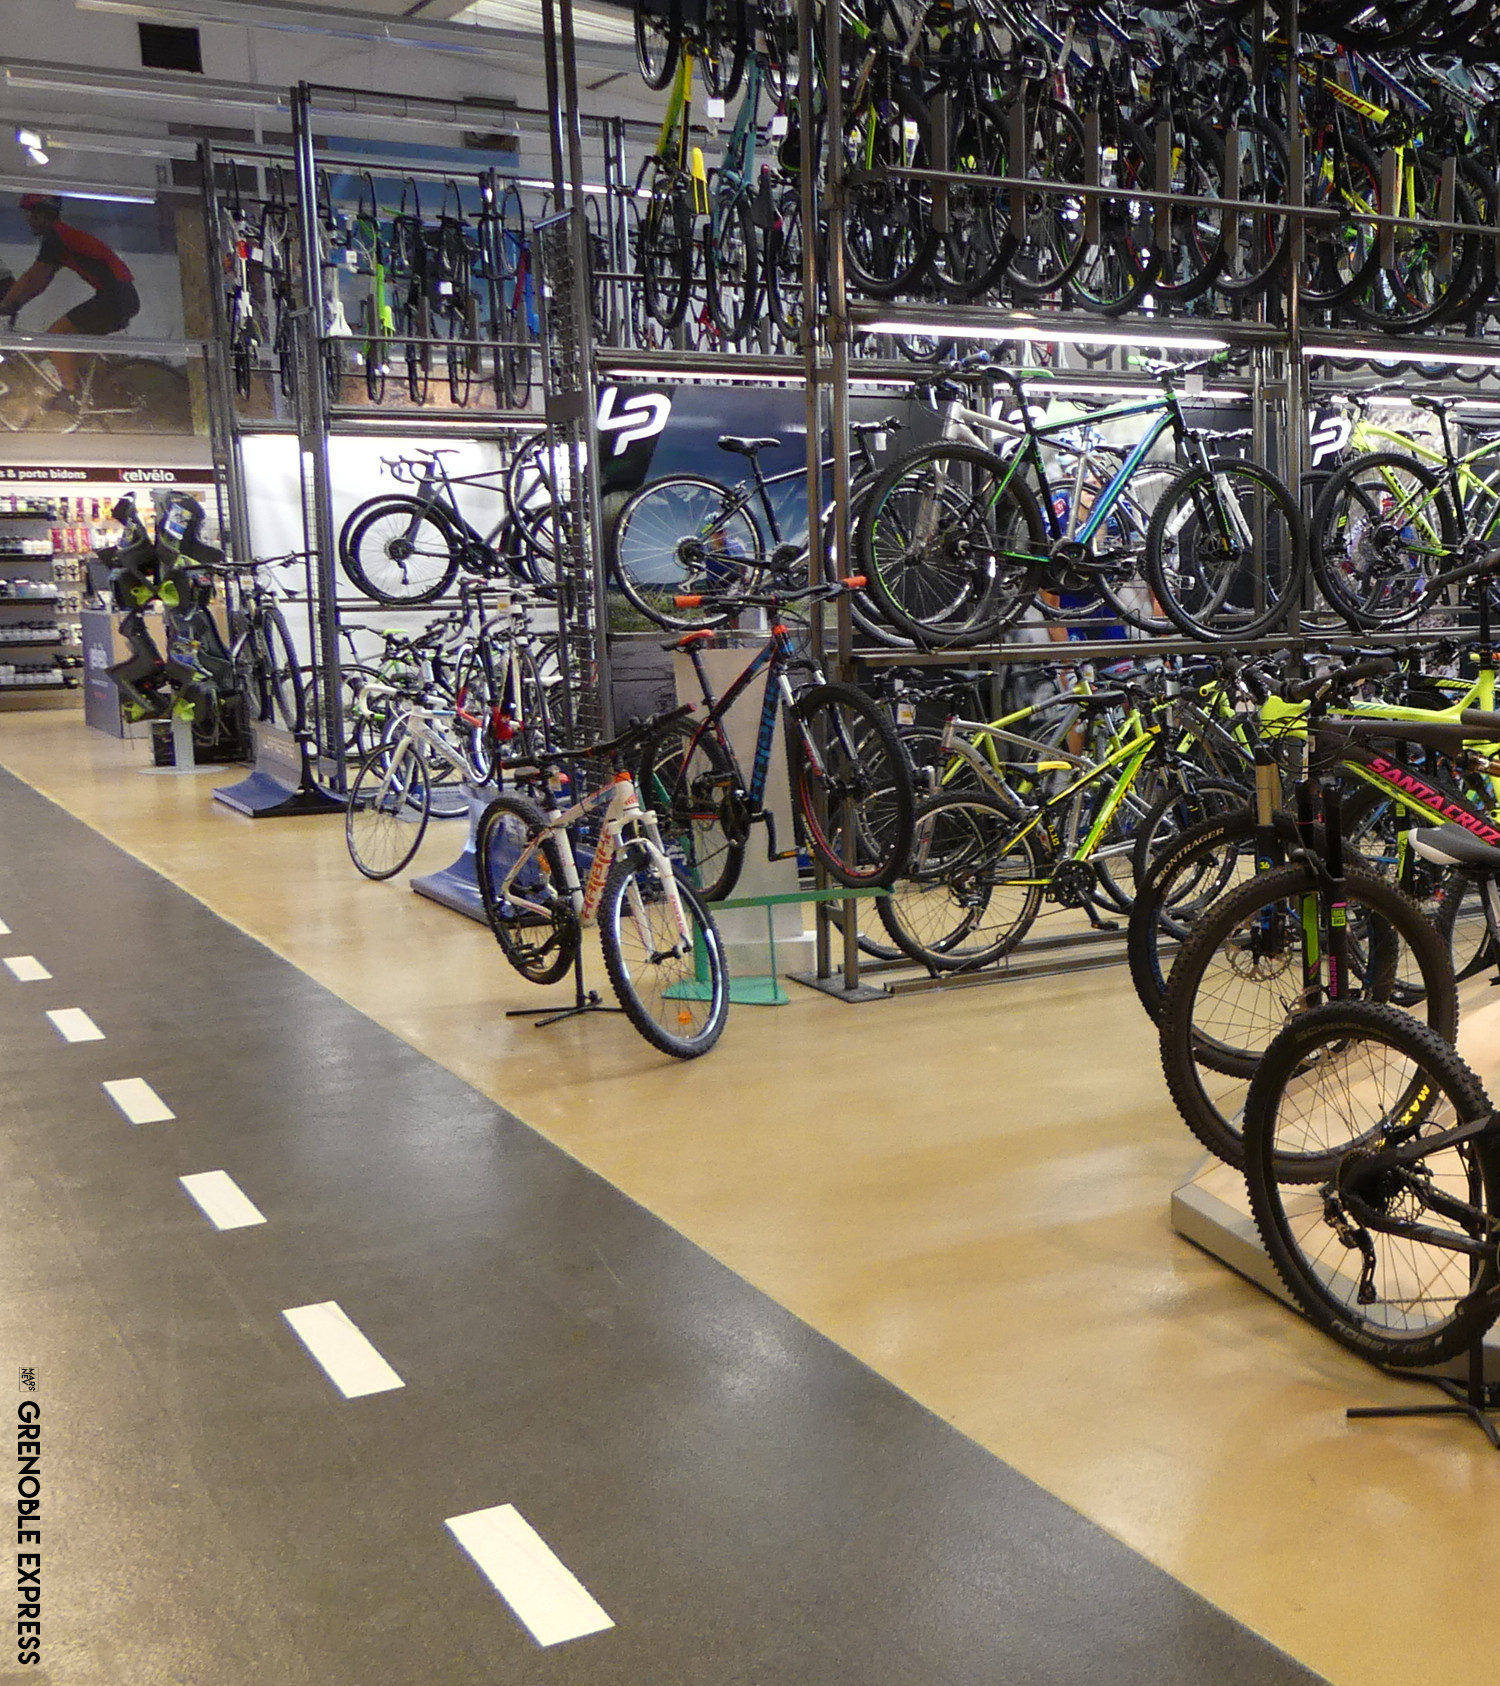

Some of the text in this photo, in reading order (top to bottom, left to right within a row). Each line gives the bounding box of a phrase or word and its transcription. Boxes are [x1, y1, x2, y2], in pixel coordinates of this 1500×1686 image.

[18, 469, 49, 480] porte
[50, 469, 87, 480] bidons
[1366, 757, 1445, 811] SANTA
[1259, 861, 1271, 870] 36
